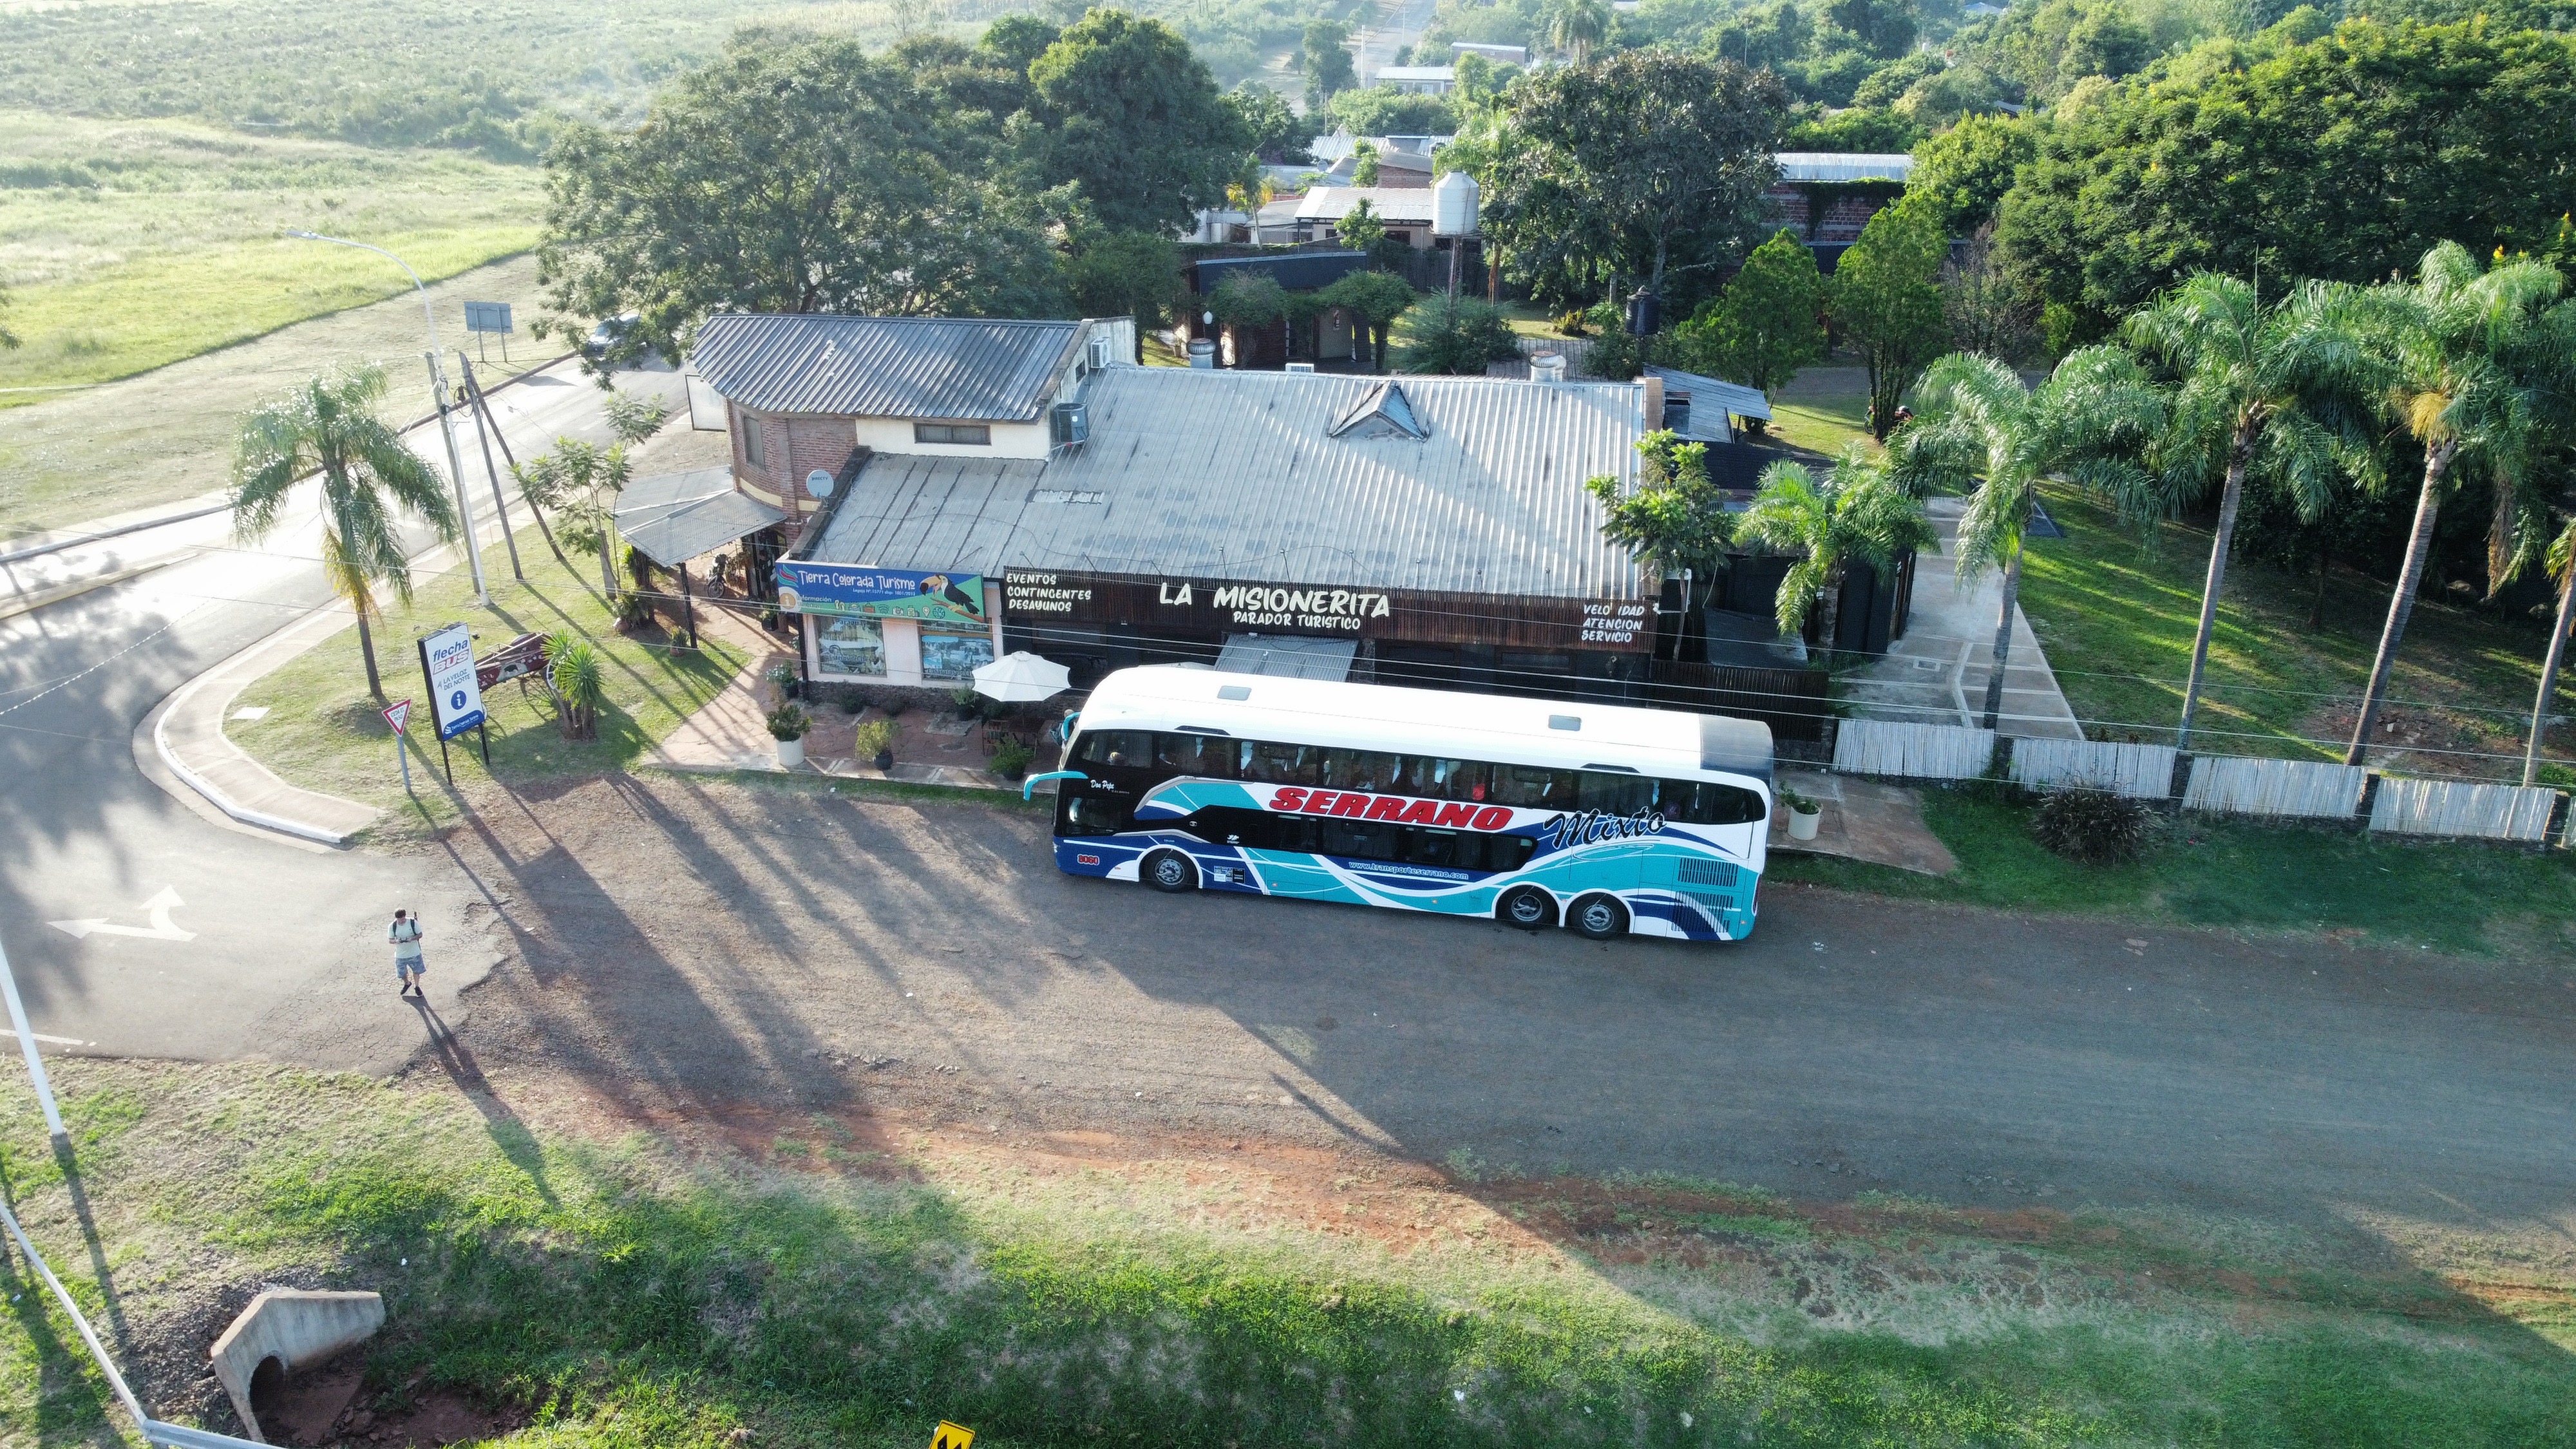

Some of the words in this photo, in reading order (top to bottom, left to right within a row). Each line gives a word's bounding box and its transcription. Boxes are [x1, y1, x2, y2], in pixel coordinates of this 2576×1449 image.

[797, 570, 830, 585] Tierra
[832, 572, 874, 588] Colorada
[876, 575, 915, 591] Turismo
[1006, 573, 1057, 585] EVENTOS
[1007, 586, 1092, 600] CONTINGENTES
[1159, 582, 1191, 605] LA
[1213, 586, 1390, 618] MISIONERITA
[1009, 598, 1072, 612] DESAYUNOS
[1233, 611, 1291, 627] PARADOR
[1297, 614, 1361, 630] TURISTICO
[1582, 618, 1643, 630] ATENCION
[1581, 629, 1633, 643] SERVICIO
[433, 639, 468, 662] flecha
[433, 648, 469, 675] BUS
[451, 668, 468, 681] VELOZ
[453, 674, 470, 686] NORTE
[1269, 787, 1514, 831] SERRANO
[1543, 806, 1667, 850] Mixto
[1348, 861, 1469, 880] www.transporteserrano.com
